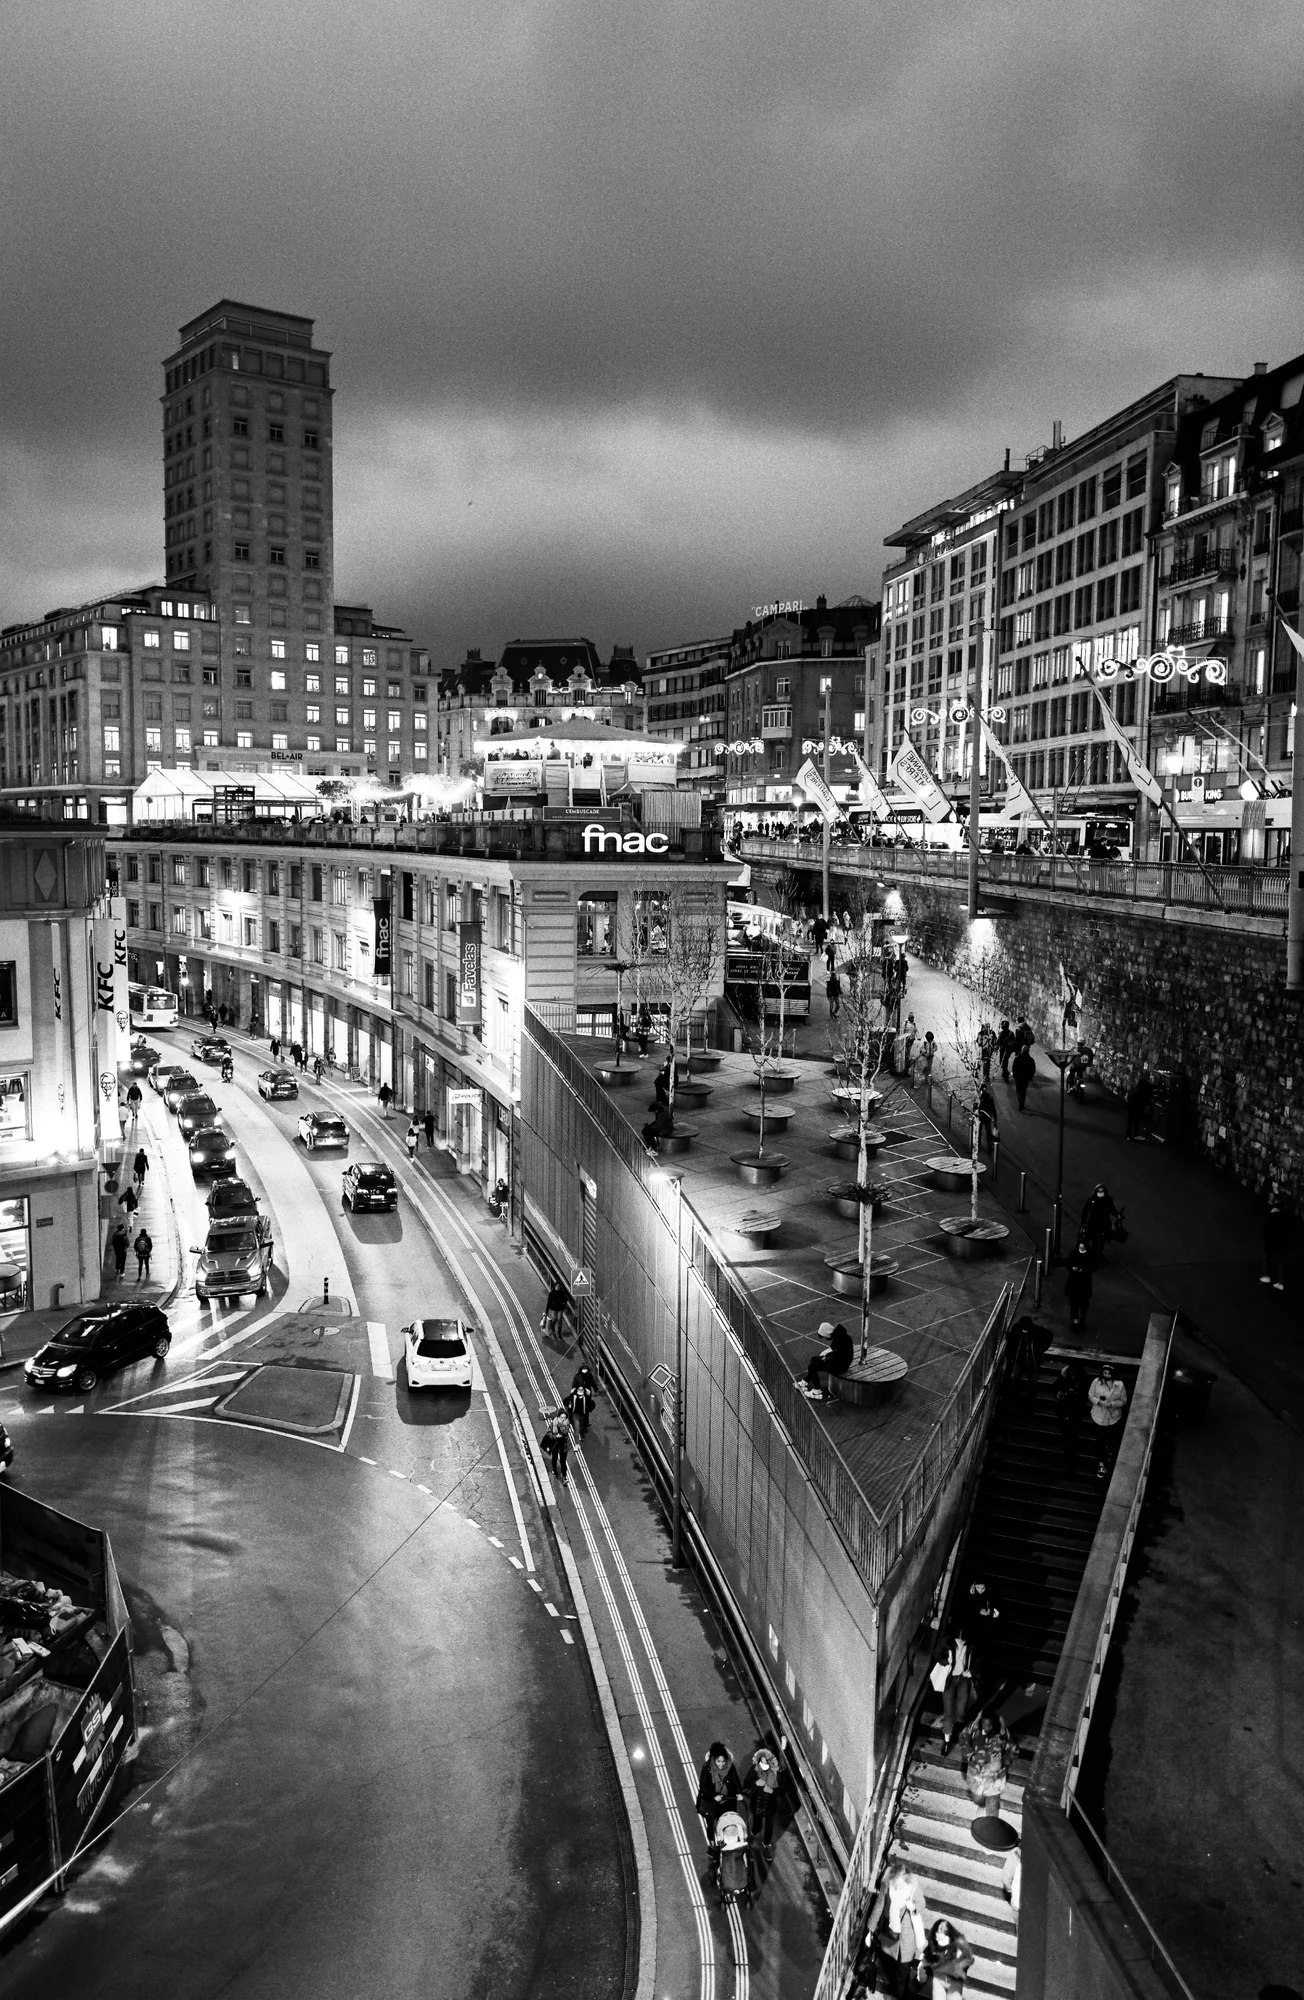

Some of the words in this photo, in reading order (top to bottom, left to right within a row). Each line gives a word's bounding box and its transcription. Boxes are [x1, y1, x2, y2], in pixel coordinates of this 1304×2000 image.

[1205, 788, 1220, 800] KING
[581, 823, 669, 853] fnac
[114, 929, 127, 967] KFC
[375, 918, 389, 959] fnac
[97, 962, 114, 1013] KFC
[462, 944, 476, 992] Favelas
[53, 968, 61, 1020] KFC
[84, 1709, 101, 1742] GS
